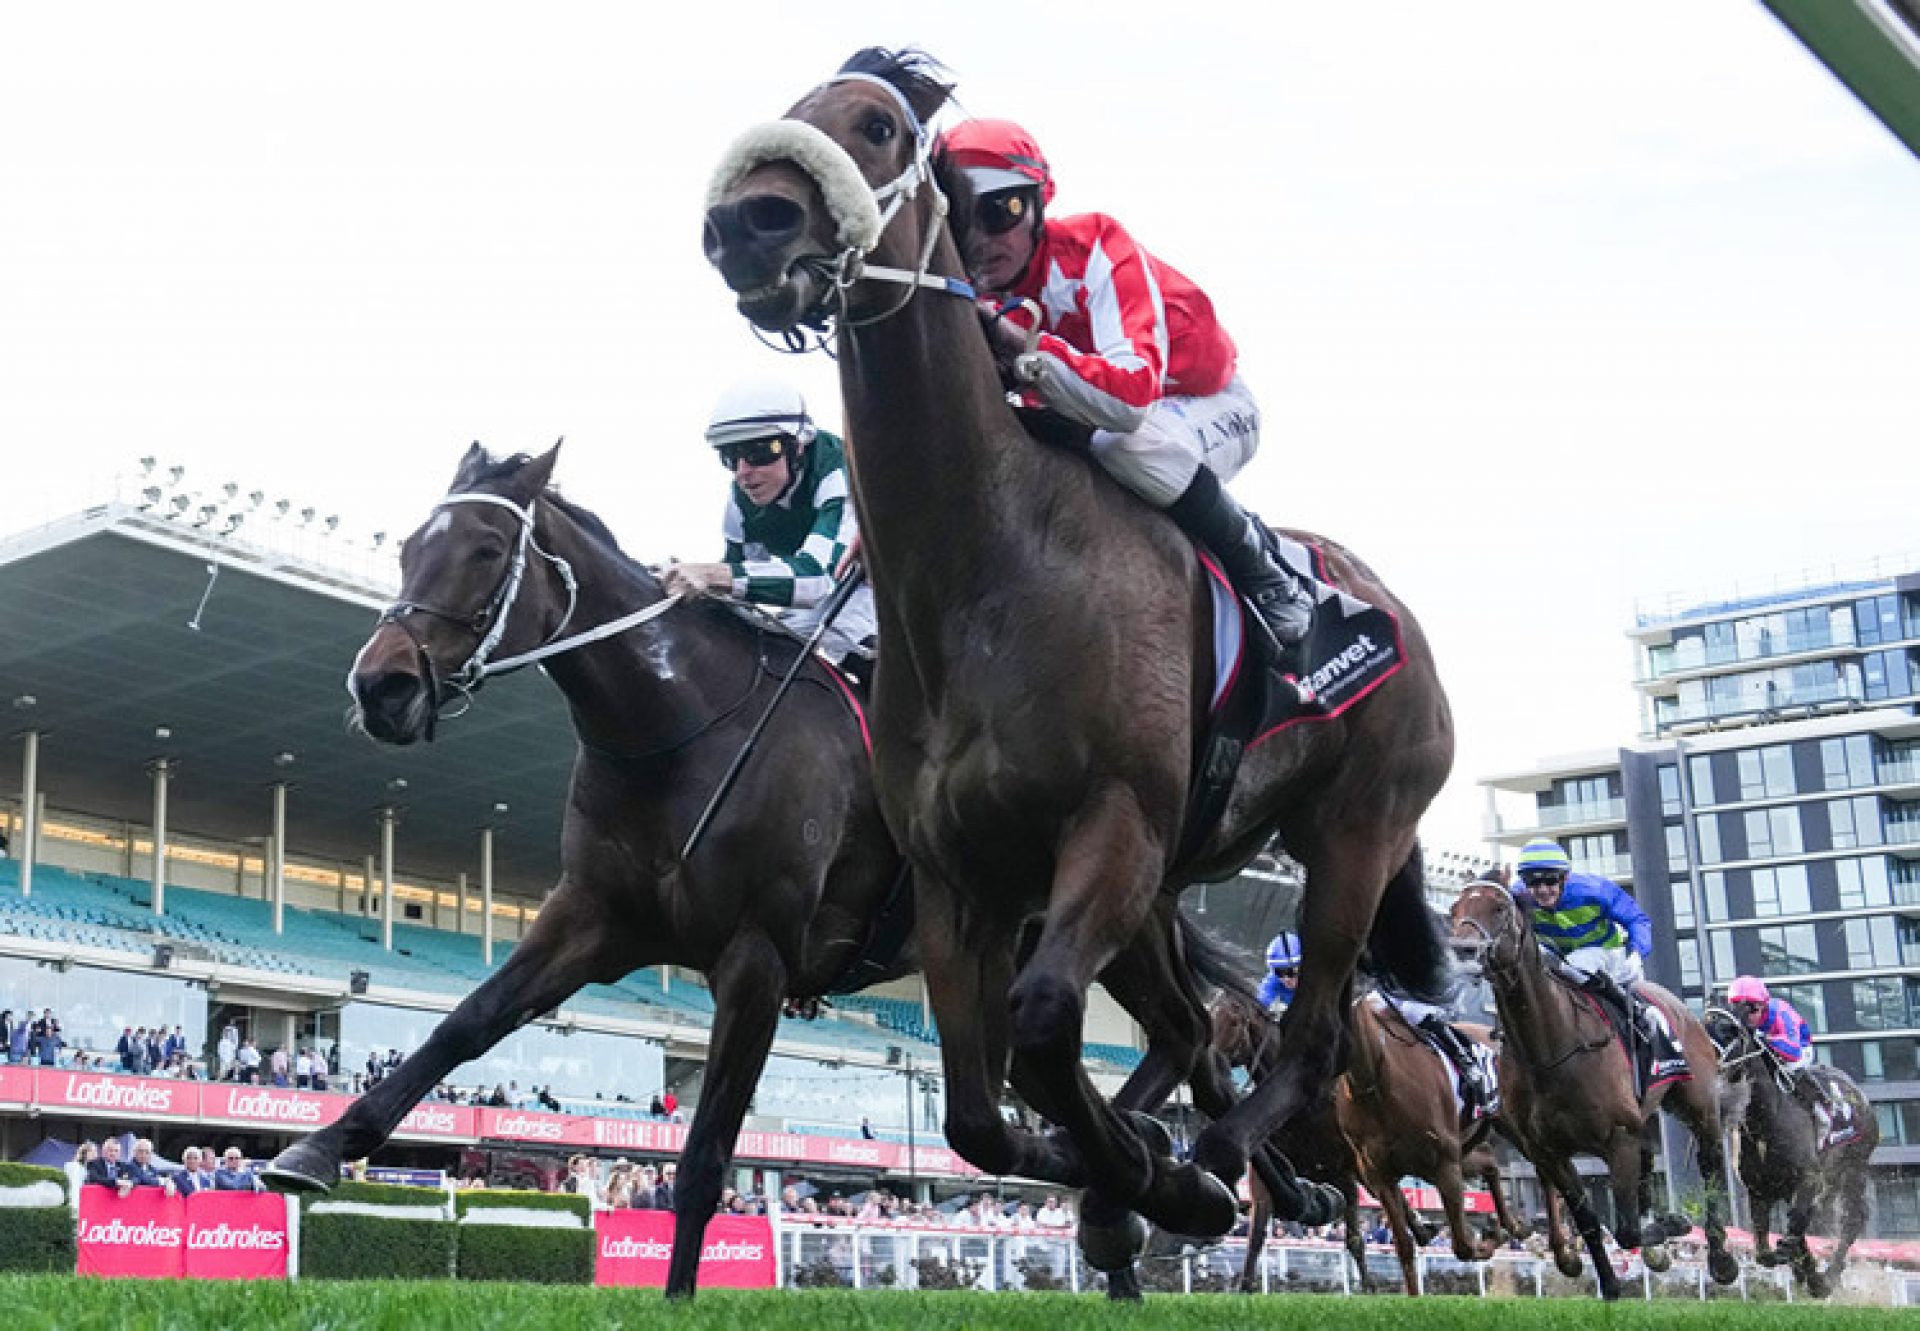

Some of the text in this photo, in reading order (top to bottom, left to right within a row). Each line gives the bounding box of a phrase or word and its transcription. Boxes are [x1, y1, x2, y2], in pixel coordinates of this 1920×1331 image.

[65, 1075, 172, 1109] Ladbrokes
[228, 1088, 321, 1121] Ladbrokes
[399, 1105, 454, 1132] rokes
[496, 1115, 563, 1138] Ladbrokes
[79, 1218, 182, 1248] Ladbrokes
[188, 1223, 284, 1249] Ladbrokes
[601, 1236, 672, 1260] Ladbrokes
[699, 1239, 763, 1262] adbrokes
